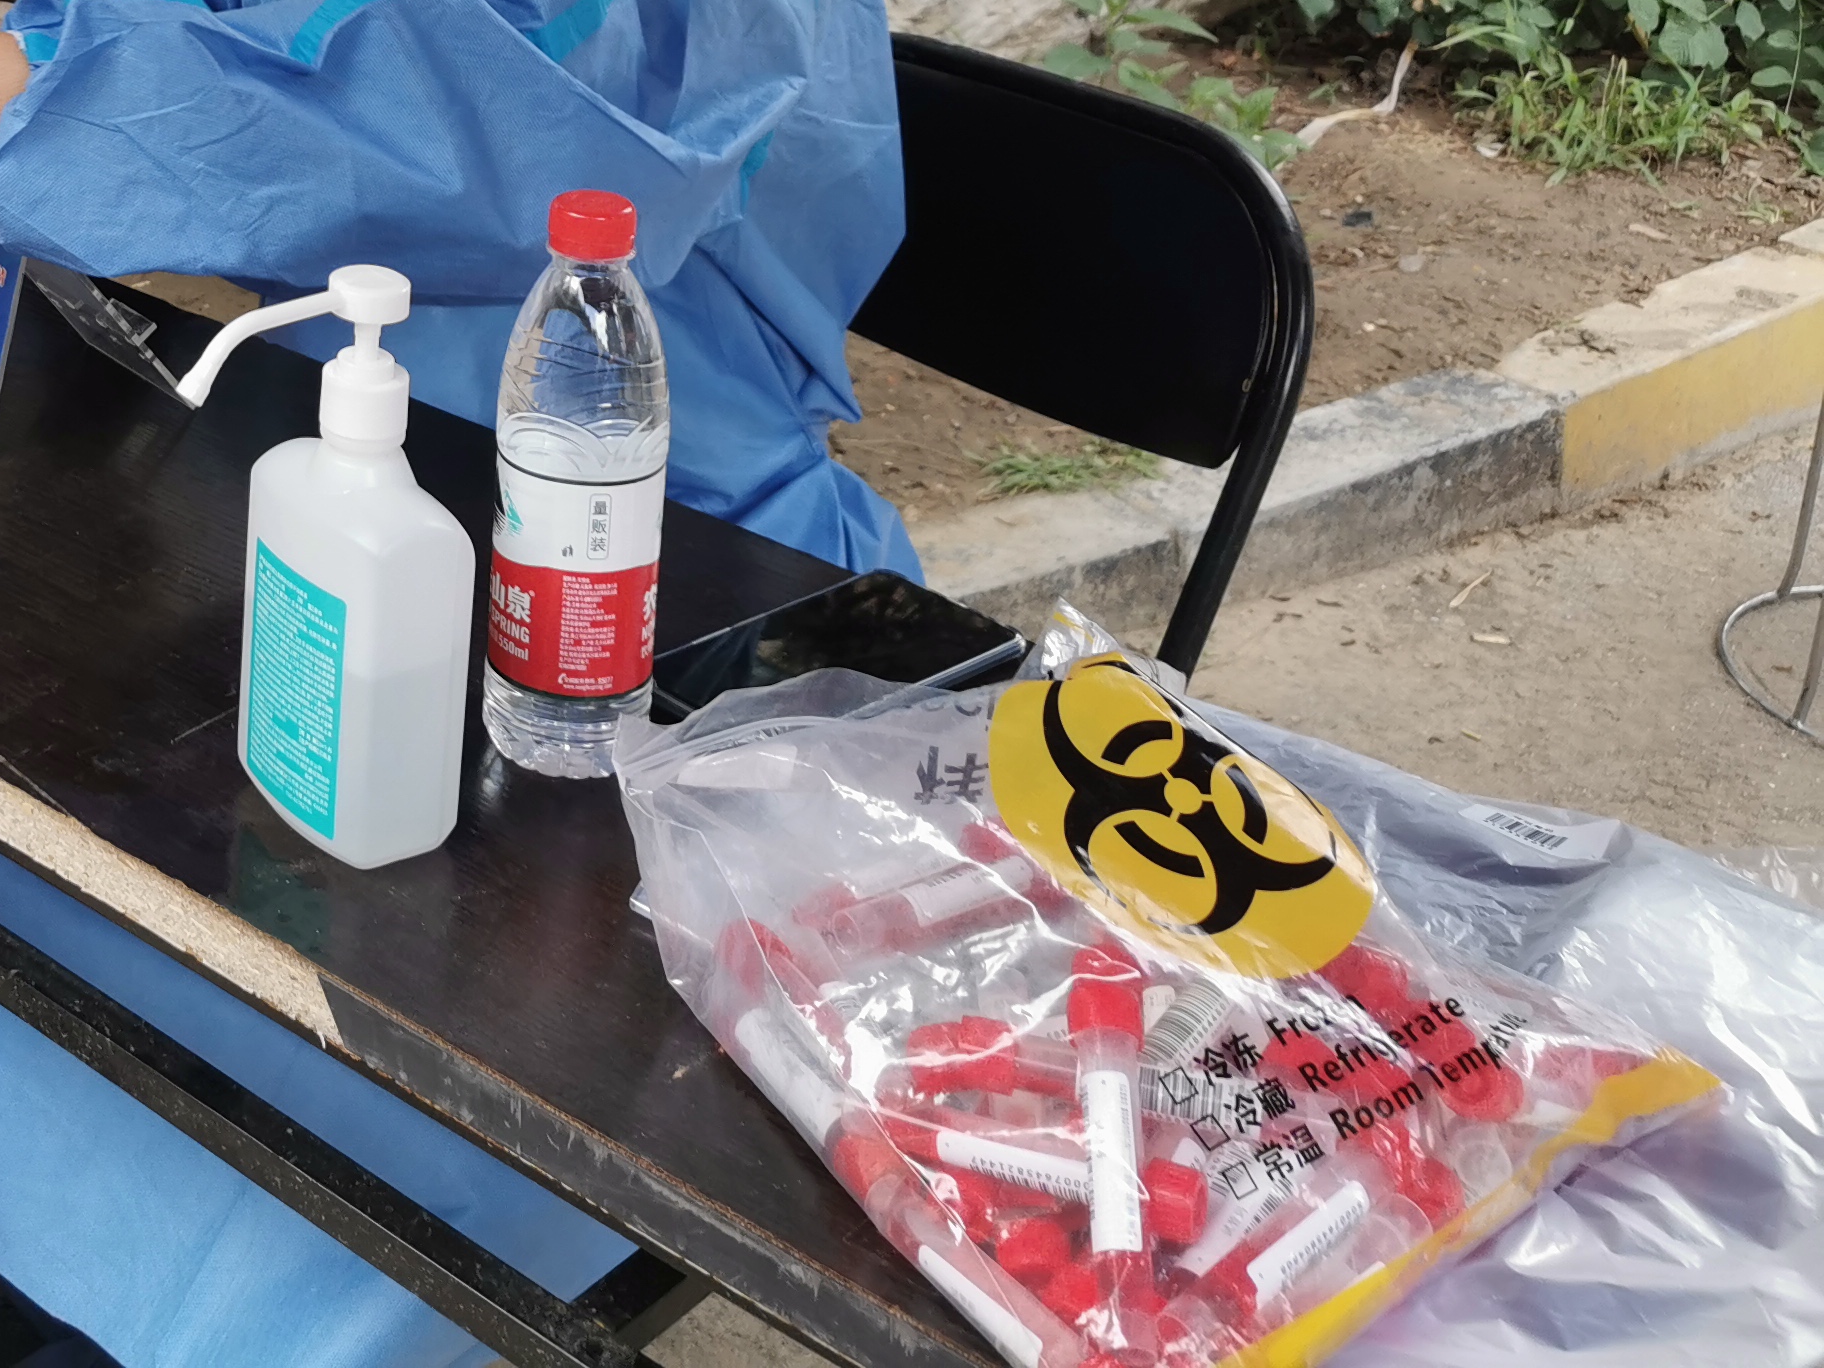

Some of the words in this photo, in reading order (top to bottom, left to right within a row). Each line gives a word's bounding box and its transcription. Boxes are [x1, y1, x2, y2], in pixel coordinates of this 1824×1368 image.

[589, 500, 609, 553] 量贩装
[490, 570, 532, 624] 山泉
[1193, 1032, 1264, 1087] 冷冻
[1224, 1077, 1297, 1134] 冷藏
[1298, 996, 1466, 1093] Refrigerate
[1256, 1123, 1327, 1183] 常温
[1328, 1078, 1425, 1142] Room
